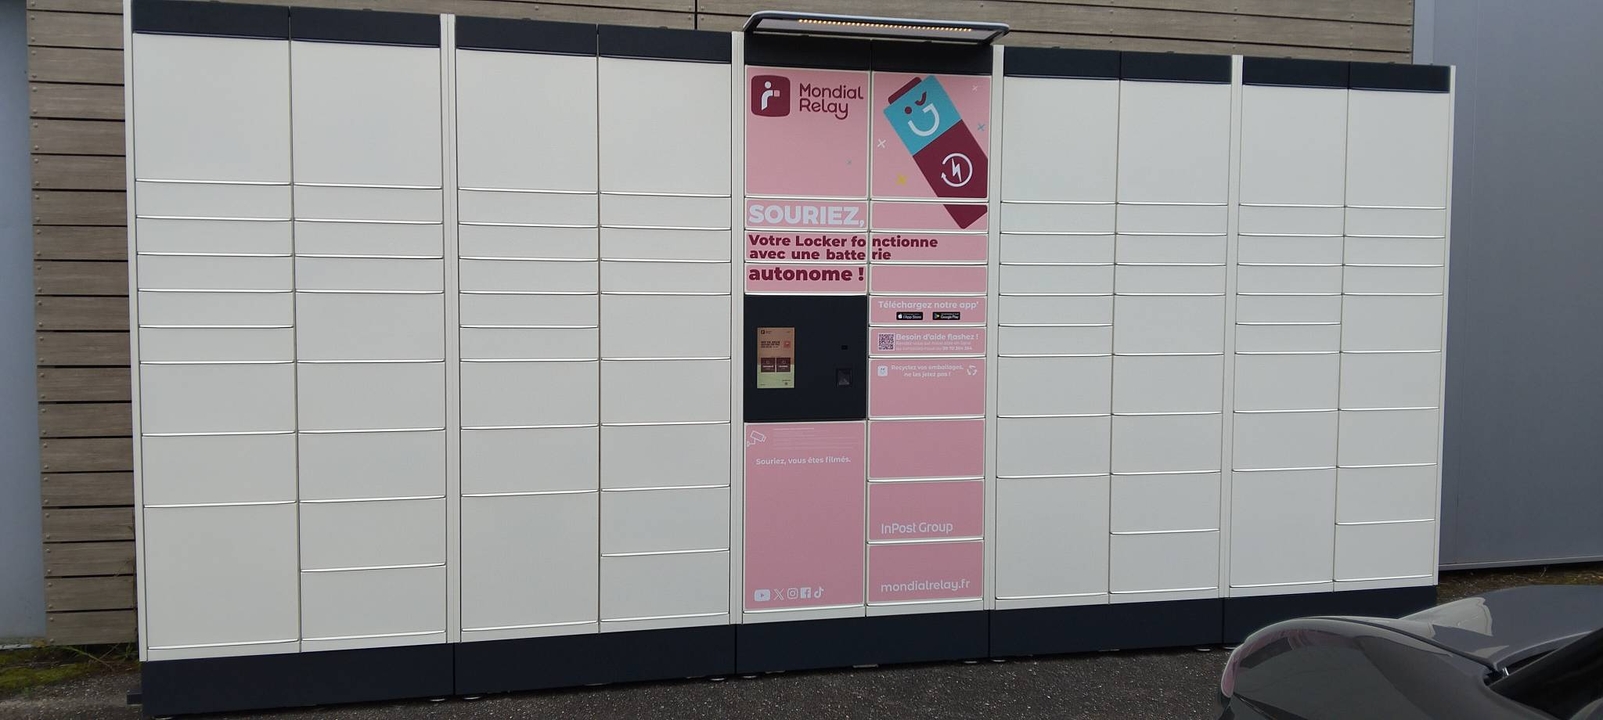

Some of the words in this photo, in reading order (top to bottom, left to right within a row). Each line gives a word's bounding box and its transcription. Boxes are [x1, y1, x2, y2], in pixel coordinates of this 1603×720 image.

[799, 83, 864, 100] Mondial
[799, 98, 849, 120] Relay
[749, 204, 865, 227] SOURIEZ,
[748, 234, 791, 247] Votre
[795, 235, 847, 247] Locker
[749, 250, 786, 260] avec
[791, 250, 820, 260] une
[748, 267, 853, 281] autonome
[858, 267, 865, 281] !
[878, 300, 931, 310] Téléchargez
[934, 301, 958, 309] notre
[756, 457, 787, 466] Souriez,
[807, 456, 824, 464] êtes
[881, 522, 916, 535] InPost
[918, 522, 954, 534] Group
[881, 579, 971, 593] mondialrelay.fr
